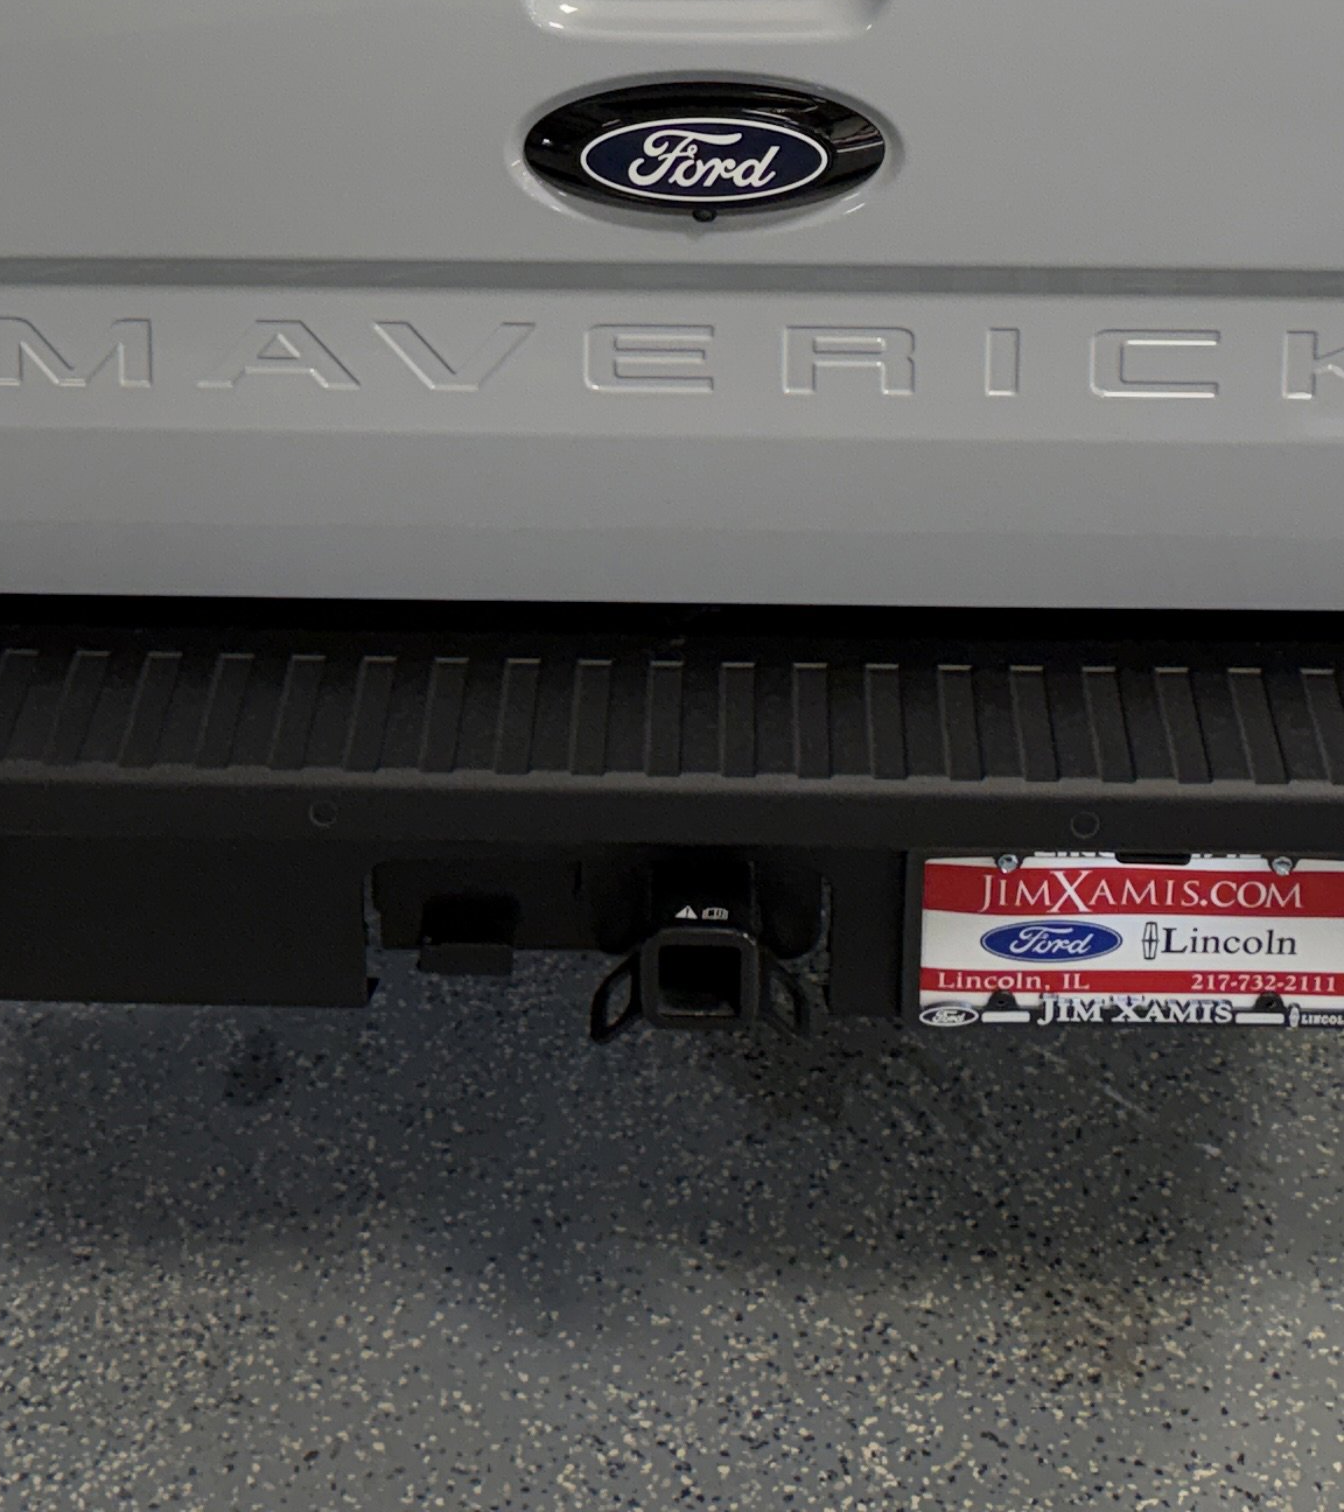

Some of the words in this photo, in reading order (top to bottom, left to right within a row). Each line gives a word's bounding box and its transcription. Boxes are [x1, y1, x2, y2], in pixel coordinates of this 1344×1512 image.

[628, 129, 780, 187] Ford
[1009, 926, 1091, 955] Ford
[1162, 927, 1298, 955] Lincoln
[938, 972, 1051, 991] Lincoln,
[1062, 973, 1090, 991] IL
[1191, 973, 1337, 992] 217-732-2111
[1037, 995, 1103, 1026] JIM
[1111, 996, 1233, 1024] XAMIS
